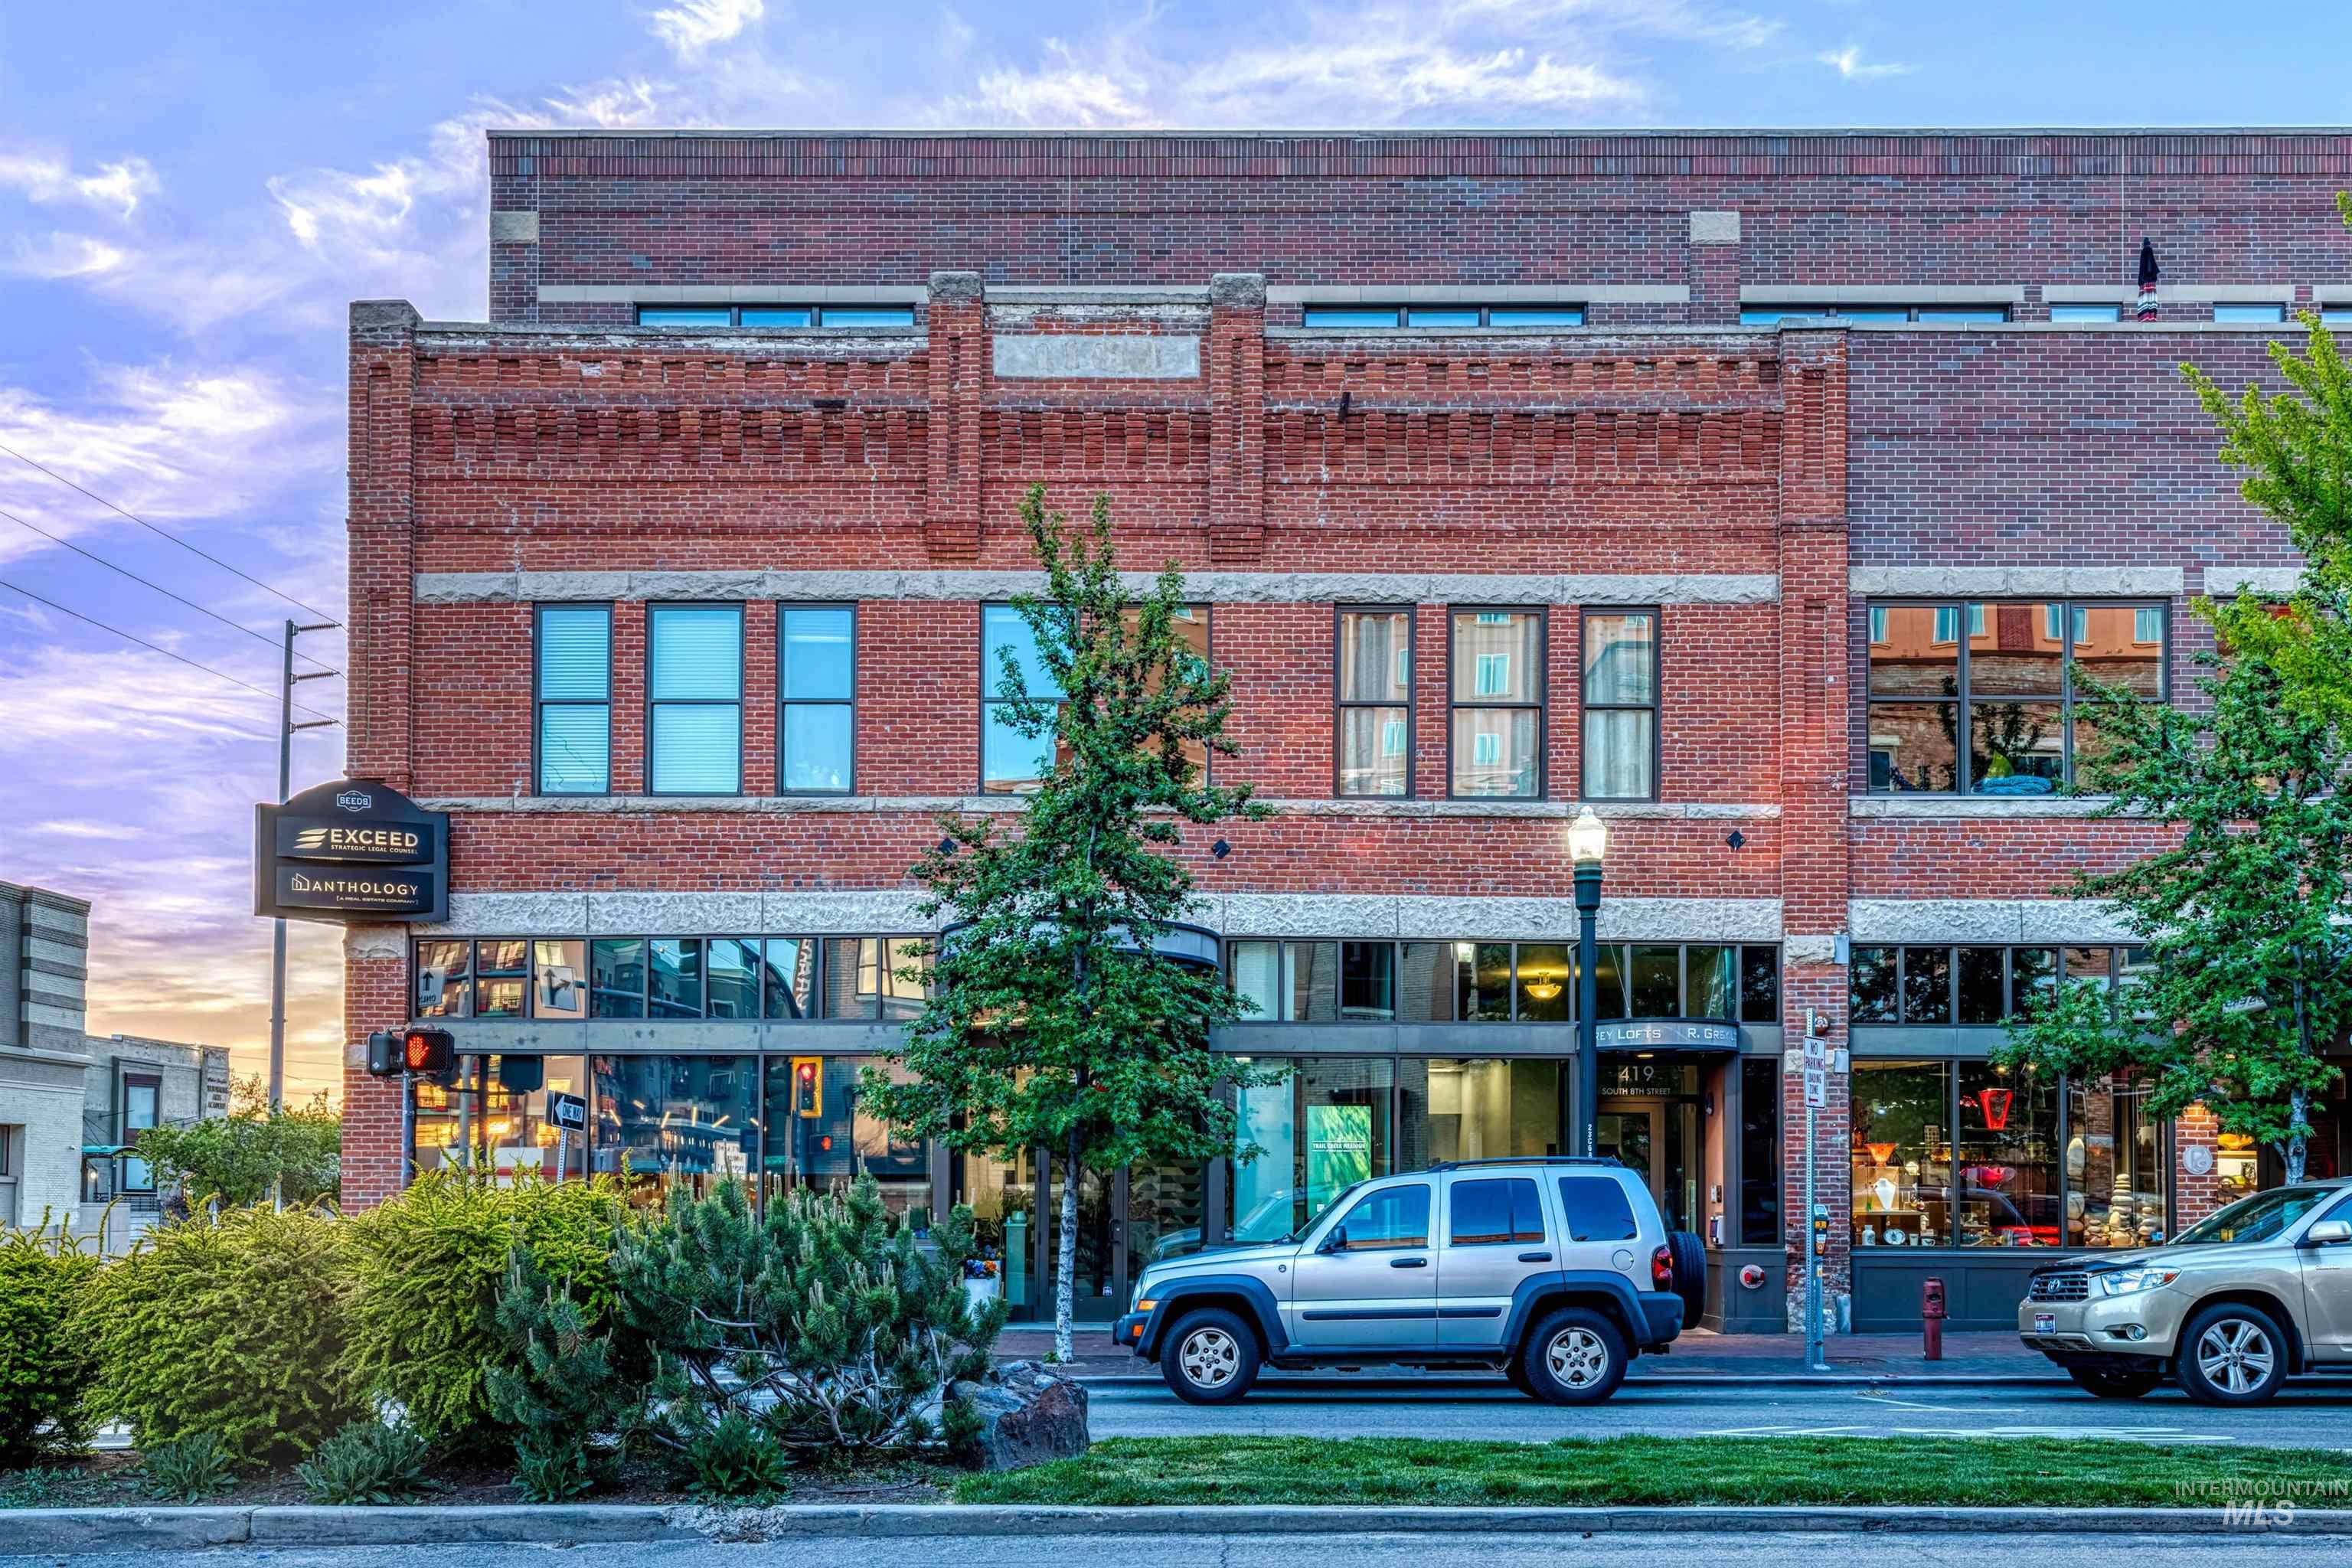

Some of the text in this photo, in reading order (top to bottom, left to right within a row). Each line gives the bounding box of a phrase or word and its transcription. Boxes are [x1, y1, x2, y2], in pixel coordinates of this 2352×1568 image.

[339, 796, 368, 805] SEEDS
[330, 828, 419, 847] EXCEED
[312, 881, 419, 895] ANTHOLOGY
[1617, 1028, 1661, 1040] LOFTS
[1687, 1027, 1700, 1039] R.
[1810, 1042, 1818, 1055] NO
[1805, 1056, 1824, 1071] PARKING
[1618, 1065, 1655, 1082] 419
[1807, 1073, 1821, 1085] LOADING
[1601, 1087, 1671, 1096] SOUTH 8TH STREET
[1809, 1084, 1819, 1096] ZONE
[563, 1104, 583, 1121] ONE WAY
